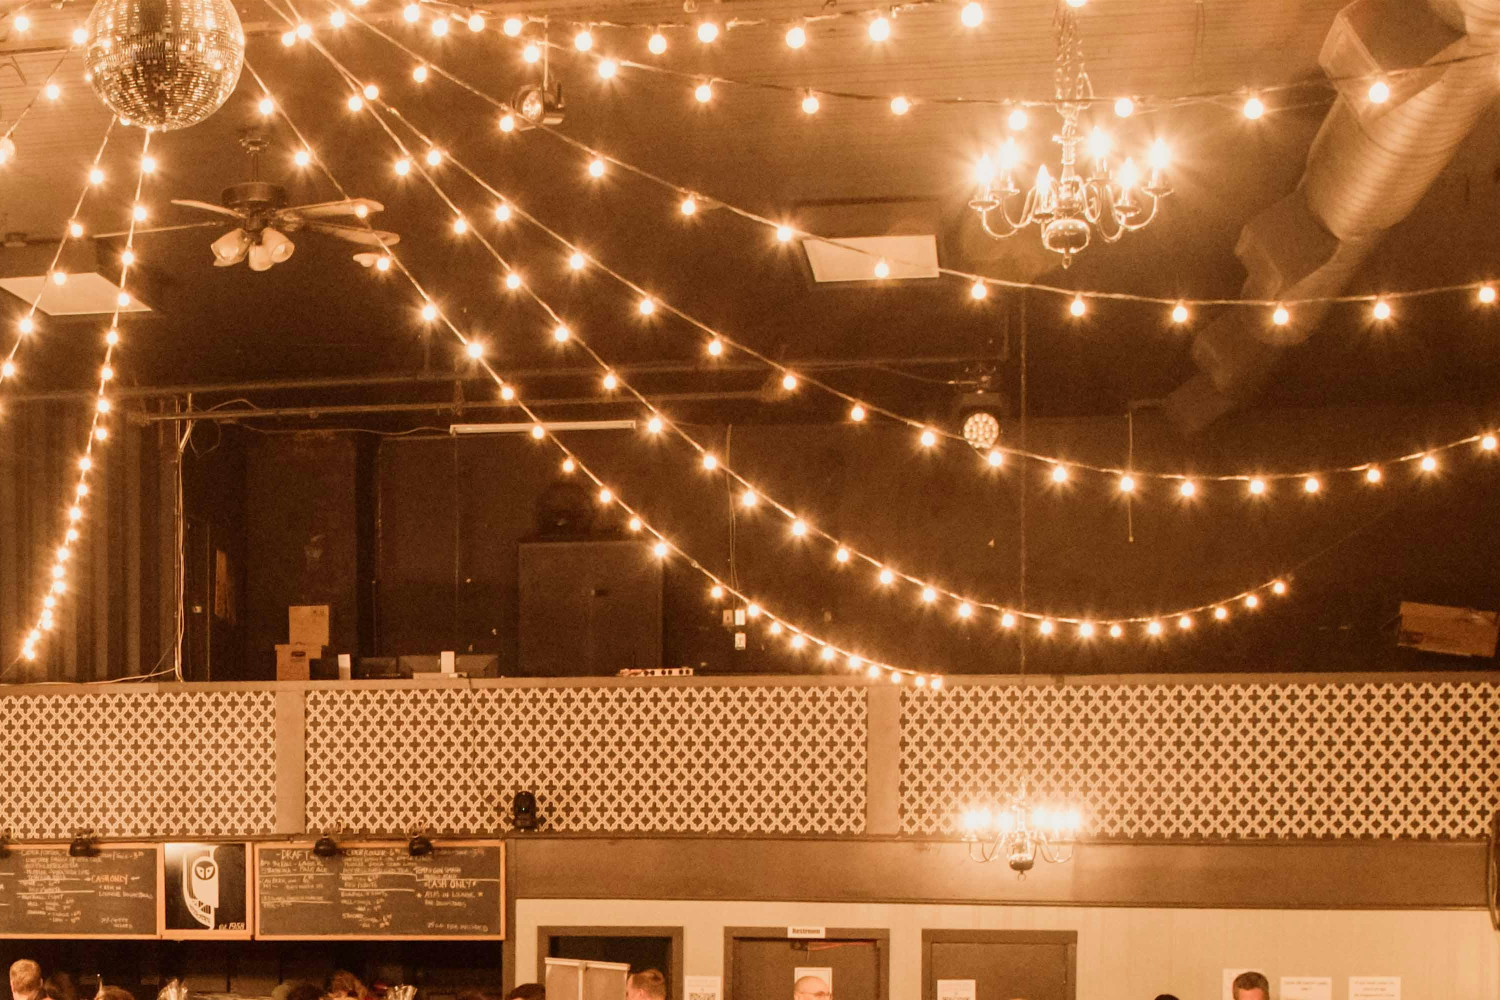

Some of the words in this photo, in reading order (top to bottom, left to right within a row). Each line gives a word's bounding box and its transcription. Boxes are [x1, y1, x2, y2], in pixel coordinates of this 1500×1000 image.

[281, 849, 310, 860] DRAFT
[428, 880, 447, 889] CASH
[449, 880, 472, 889] ONLY
